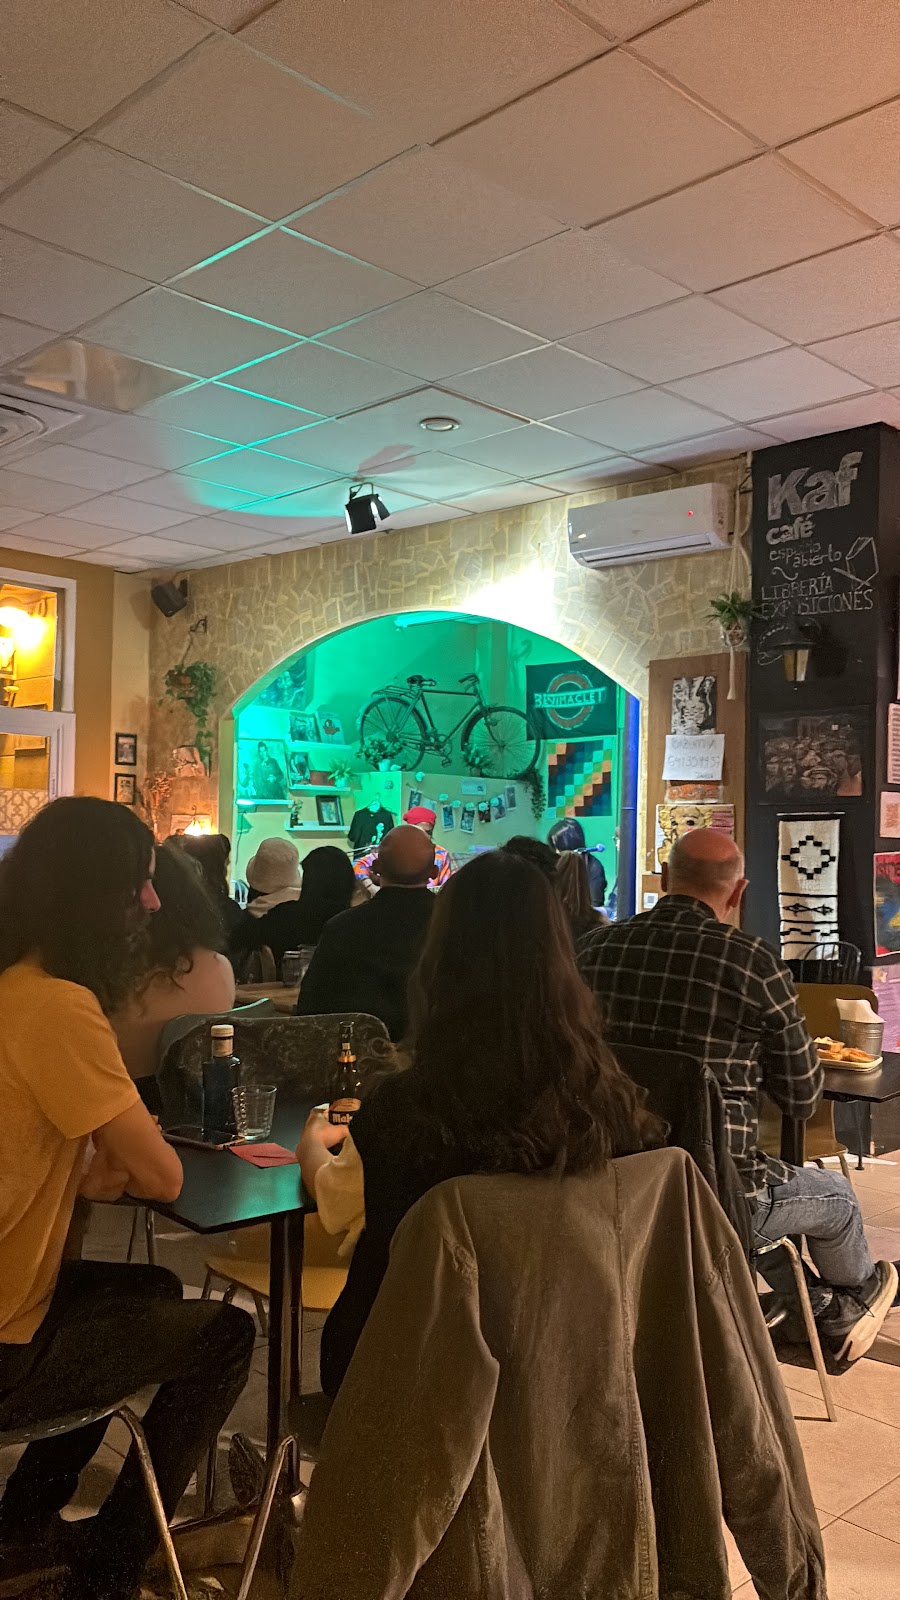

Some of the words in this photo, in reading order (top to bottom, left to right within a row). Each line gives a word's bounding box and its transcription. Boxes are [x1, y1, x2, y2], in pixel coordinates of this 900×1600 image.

[767, 451, 863, 521] Kaf
[766, 513, 815, 545] café
[793, 544, 842, 568] abierto
[761, 572, 833, 600] LIBRERÍA
[761, 588, 873, 618] EXPSICIONES
[332, 1113, 353, 1124] Mah
